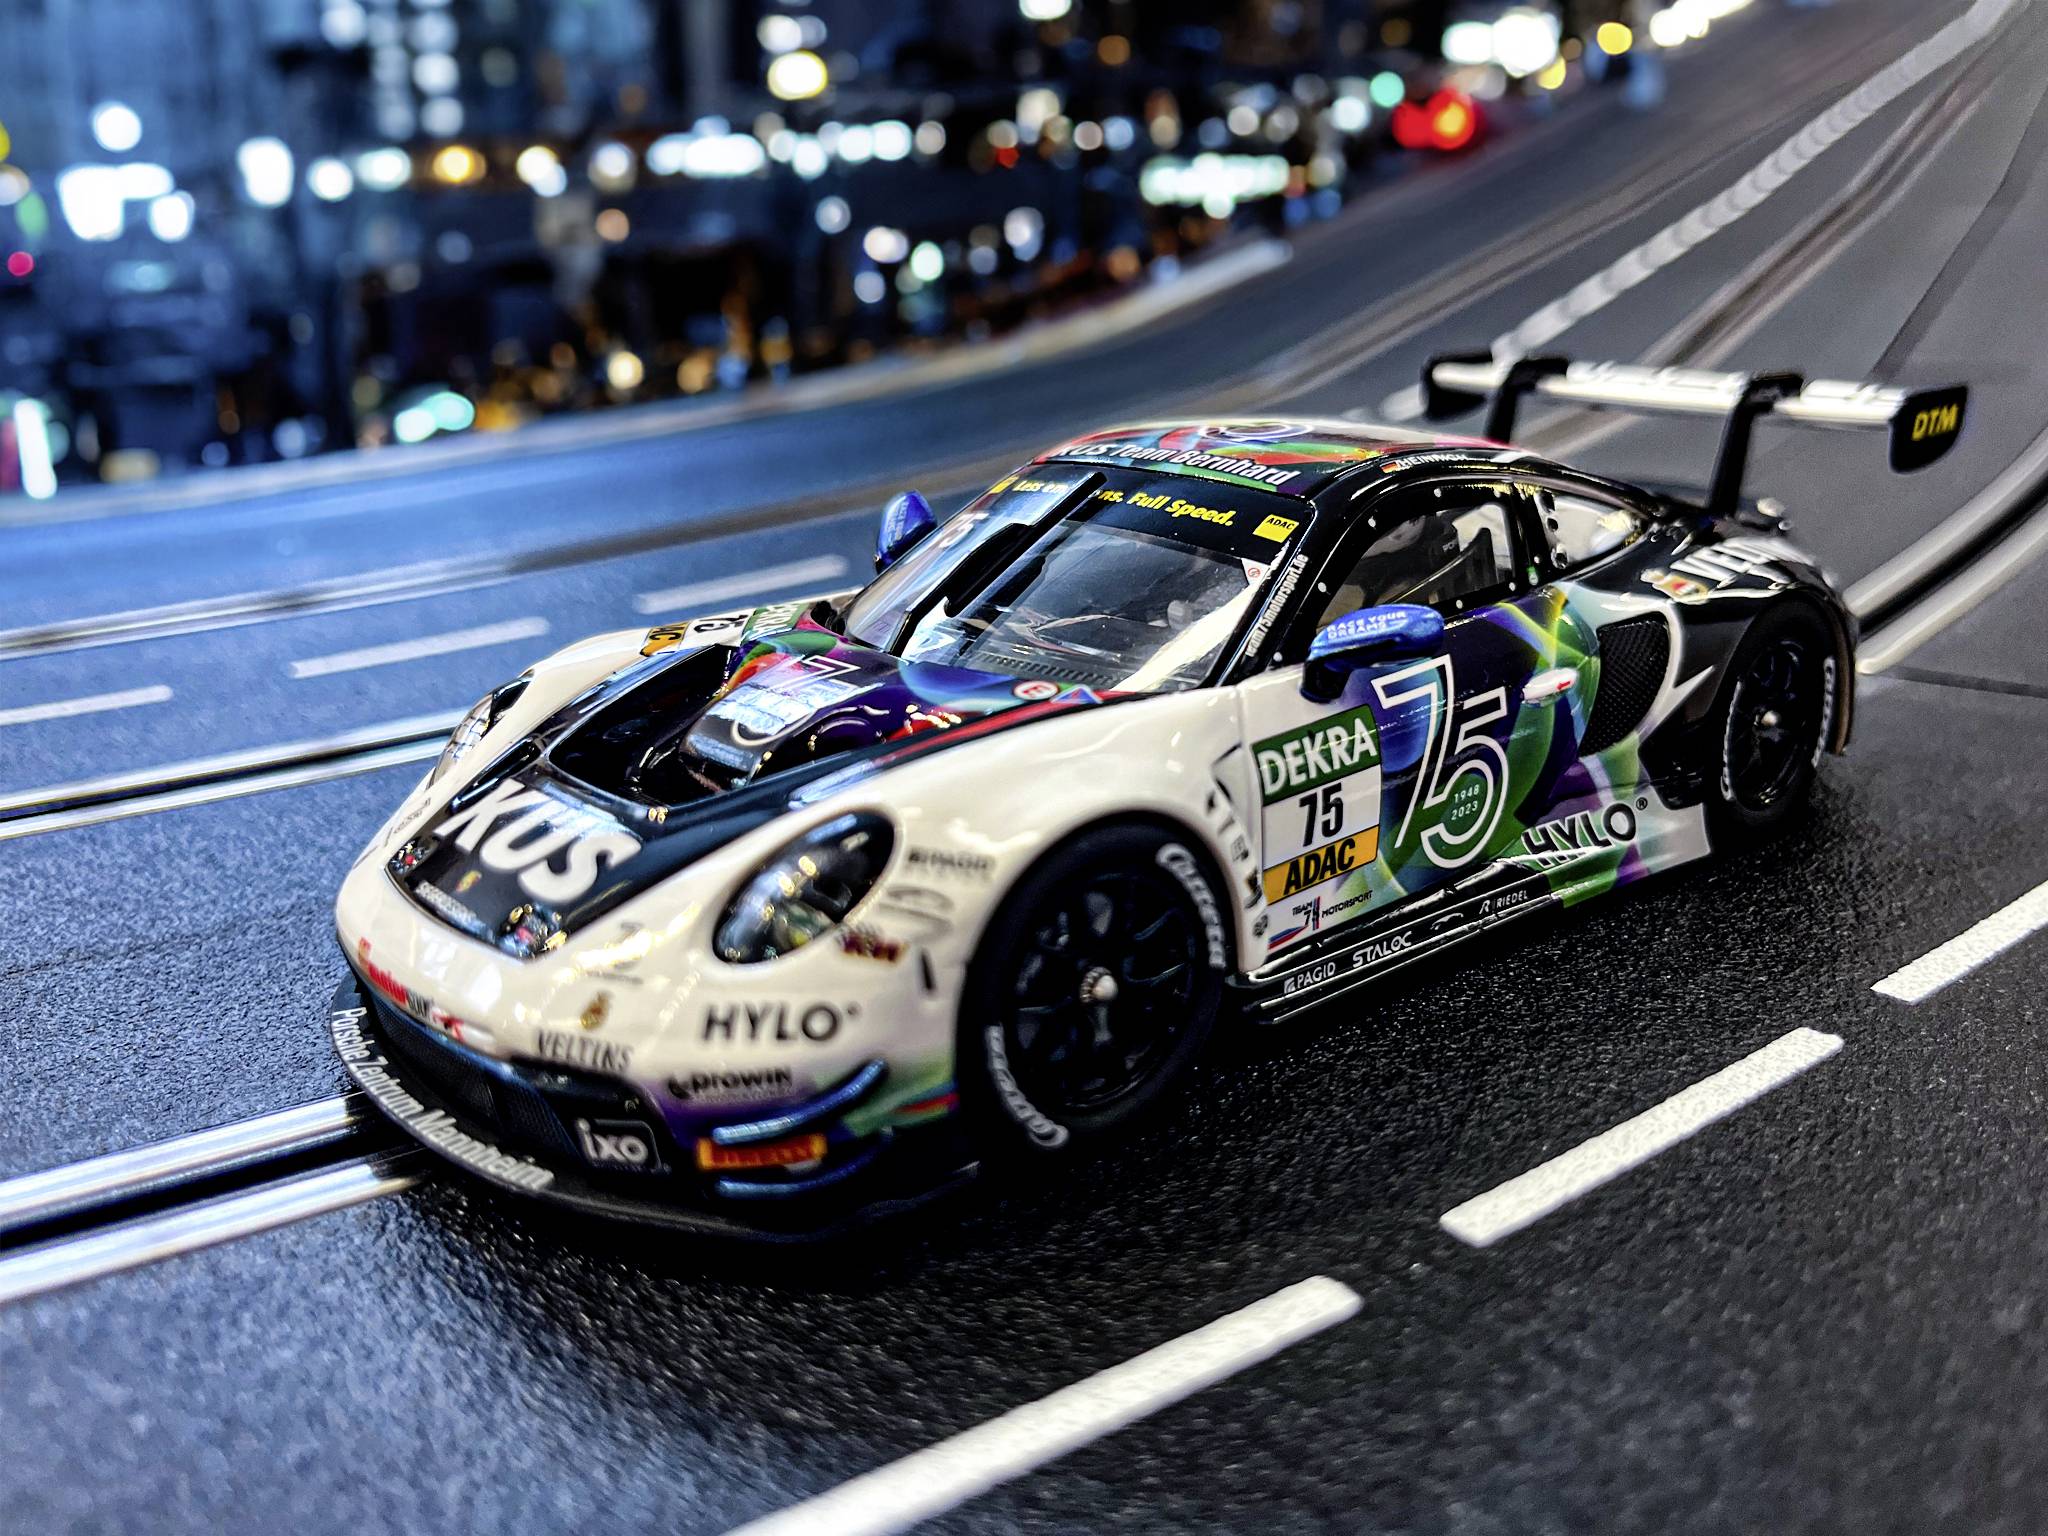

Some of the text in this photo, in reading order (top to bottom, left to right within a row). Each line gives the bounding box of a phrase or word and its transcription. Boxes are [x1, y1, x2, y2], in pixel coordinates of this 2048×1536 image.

[1912, 404, 1959, 441] DTM
[1112, 444, 1173, 462] Team
[1171, 450, 1302, 486] Bernhard
[1126, 491, 1172, 511] Full
[1164, 500, 1238, 527] Speed.
[1266, 515, 1296, 531] ADAC
[1367, 610, 1407, 624] YOUR
[1257, 718, 1378, 796] DEKRA
[1370, 653, 1510, 869] 75
[1298, 782, 1344, 848] 75
[1450, 800, 1479, 821] 2023
[1453, 784, 1480, 804] 1948
[432, 778, 642, 902] KUS
[1283, 838, 1356, 896] ADAC
[1321, 889, 1374, 919] MOTORSPORT
[1496, 890, 1529, 909] RIEDEL
[1296, 930, 1413, 989] PAGID STALOC
[538, 1030, 634, 1073] VELTINS
[332, 1006, 555, 1191] Porsche Zentrum Mannheim
[577, 1117, 649, 1165] ixo
